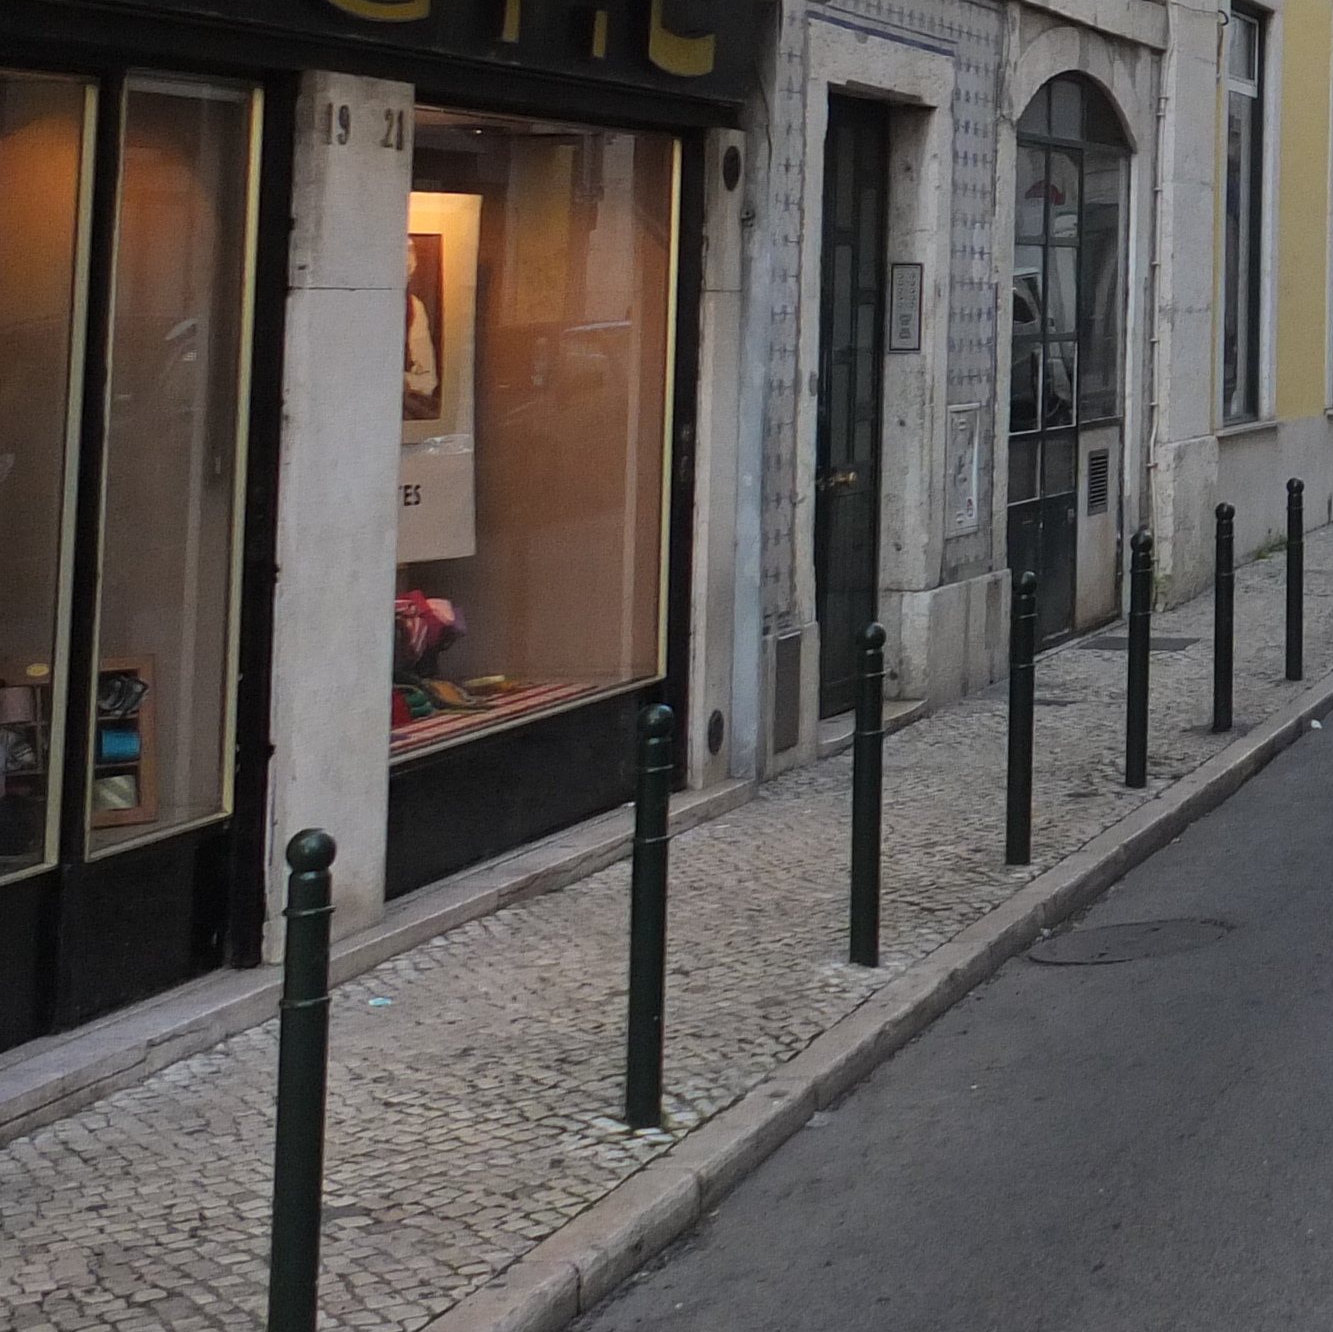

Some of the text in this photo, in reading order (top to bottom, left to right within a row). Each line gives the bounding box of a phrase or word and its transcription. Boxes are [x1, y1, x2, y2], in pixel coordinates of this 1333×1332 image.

[325, 102, 404, 151] 19 21
[399, 484, 421, 506] ES
